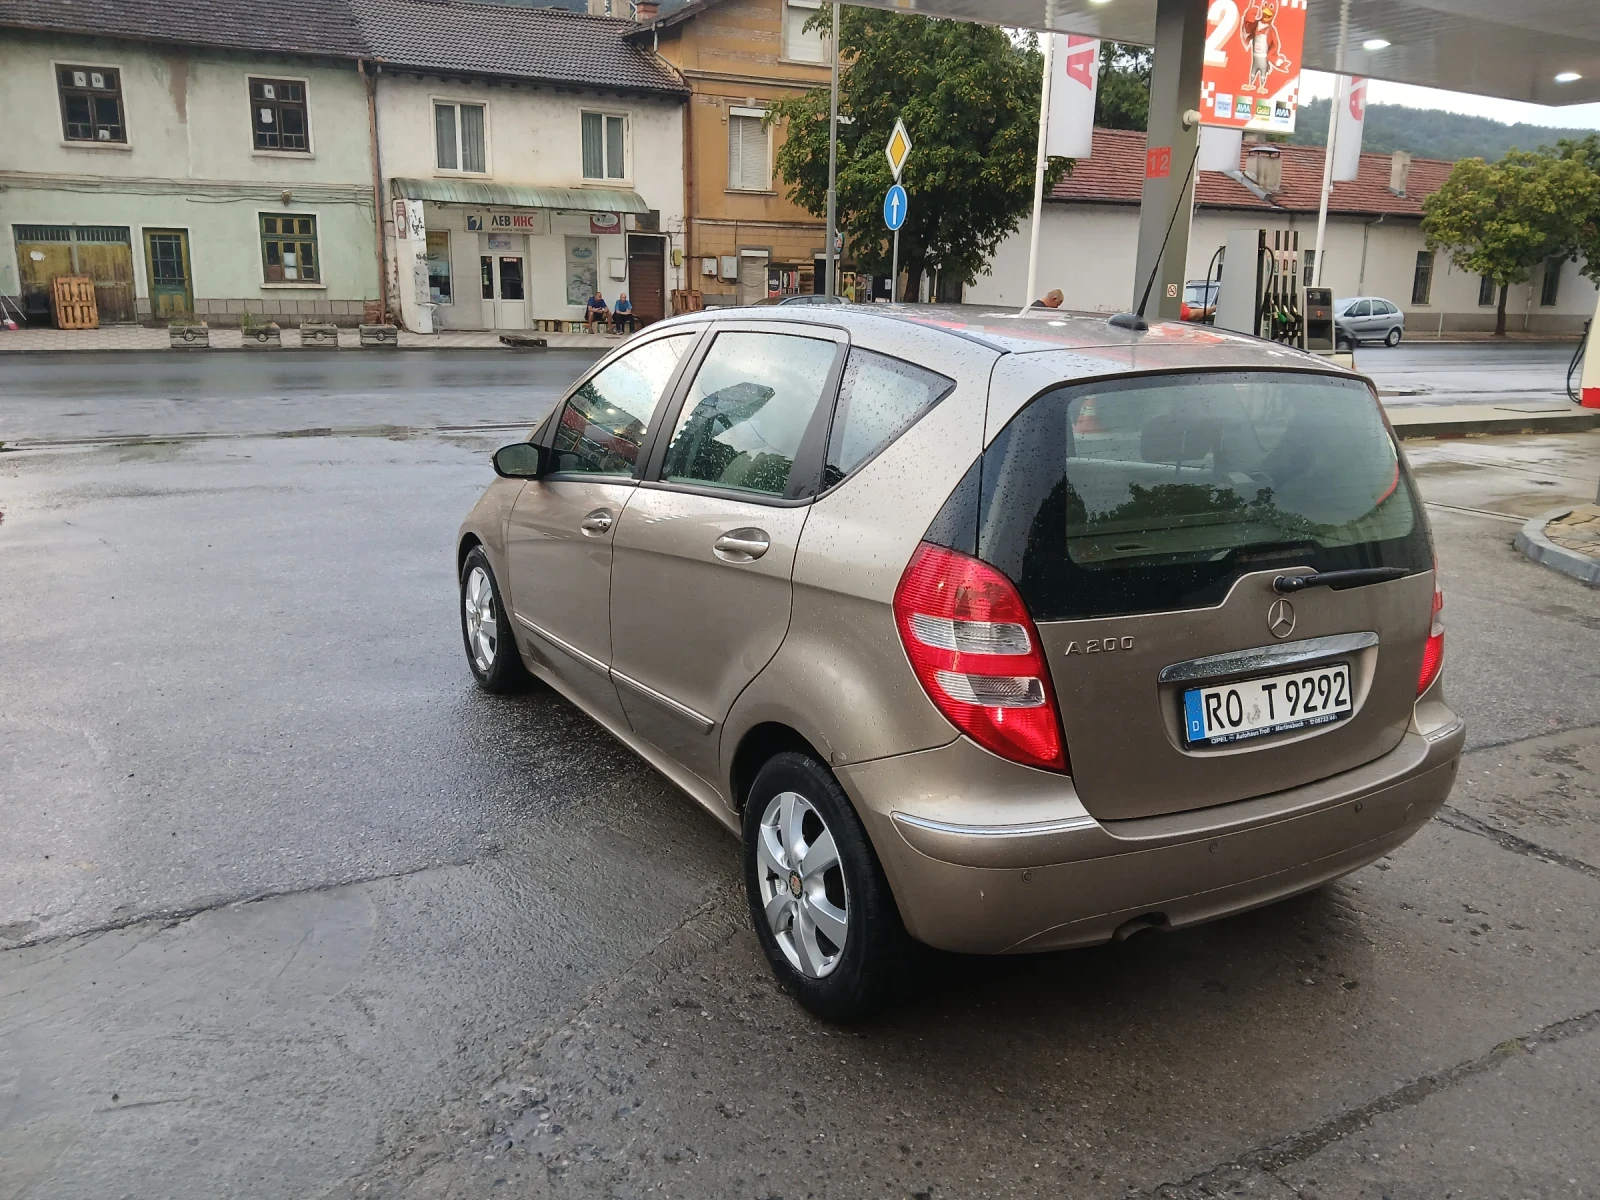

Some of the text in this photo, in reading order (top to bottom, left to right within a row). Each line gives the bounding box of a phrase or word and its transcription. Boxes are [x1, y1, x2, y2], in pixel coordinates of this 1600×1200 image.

[1256, 106, 1270, 115] Gold
[1160, 154, 1168, 170] 2
[491, 215, 534, 227] ЛЕВ ИНС
[1204, 671, 1348, 732] RO T 9292
[1192, 720, 1200, 732] D
